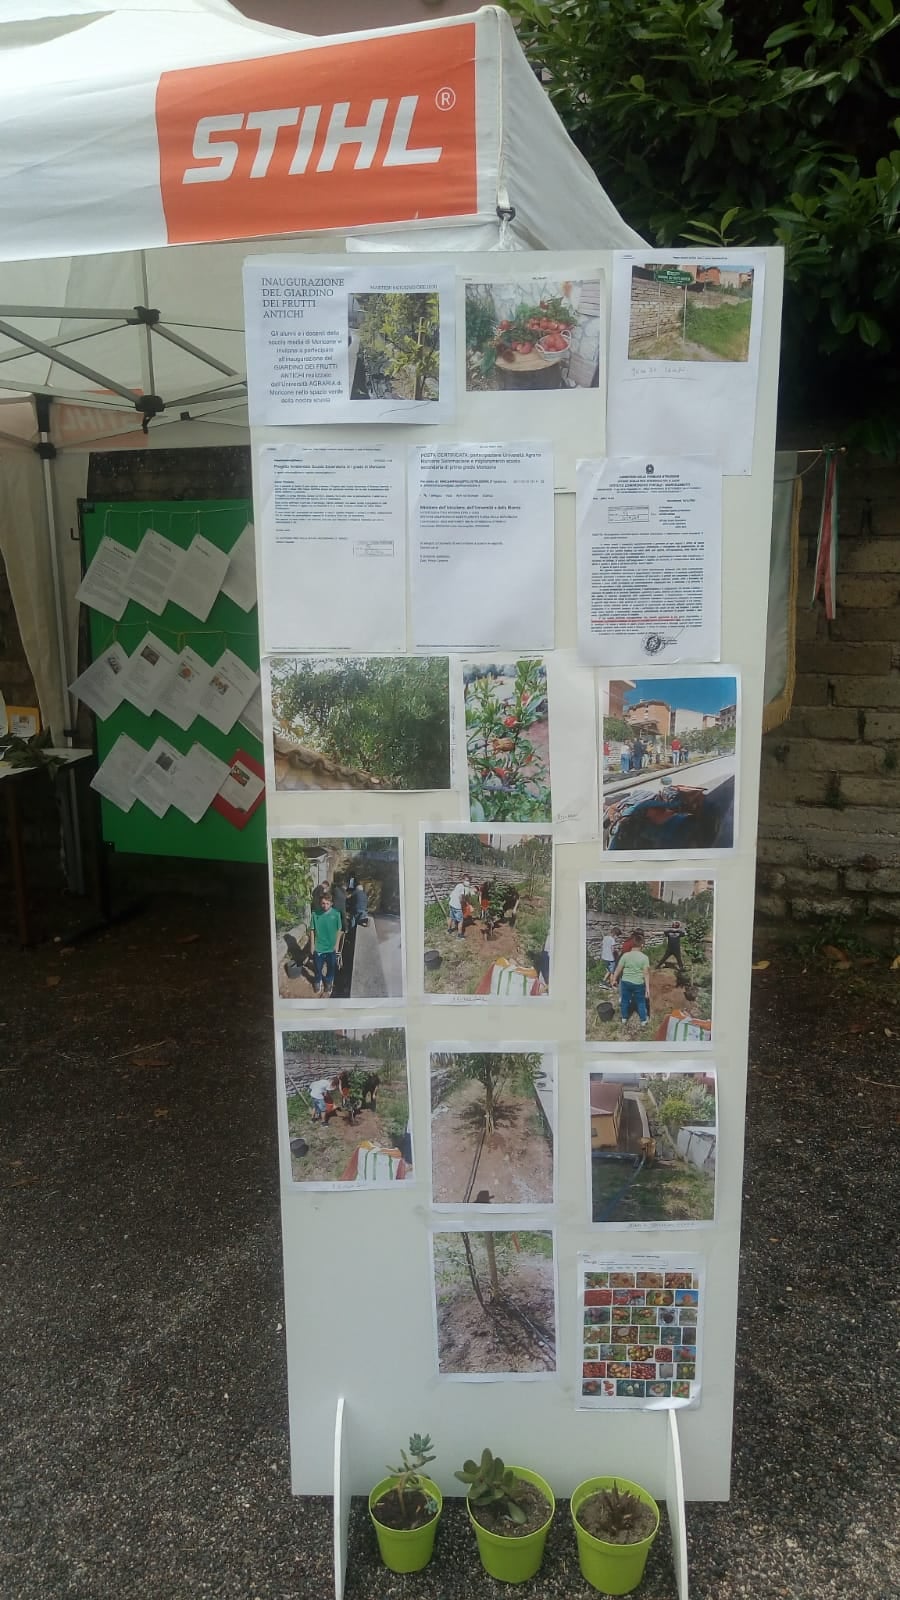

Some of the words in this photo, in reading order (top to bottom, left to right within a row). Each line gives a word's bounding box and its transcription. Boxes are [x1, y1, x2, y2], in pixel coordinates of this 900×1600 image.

[182, 95, 443, 184] STIHL
[261, 277, 345, 287] INAUGURAZIONE
[262, 288, 282, 297] DEL
[284, 288, 334, 297] GIARDINO
[263, 299, 280, 308] DEI
[282, 299, 316, 308] FRUTTI
[263, 310, 304, 318] ANTICHI
